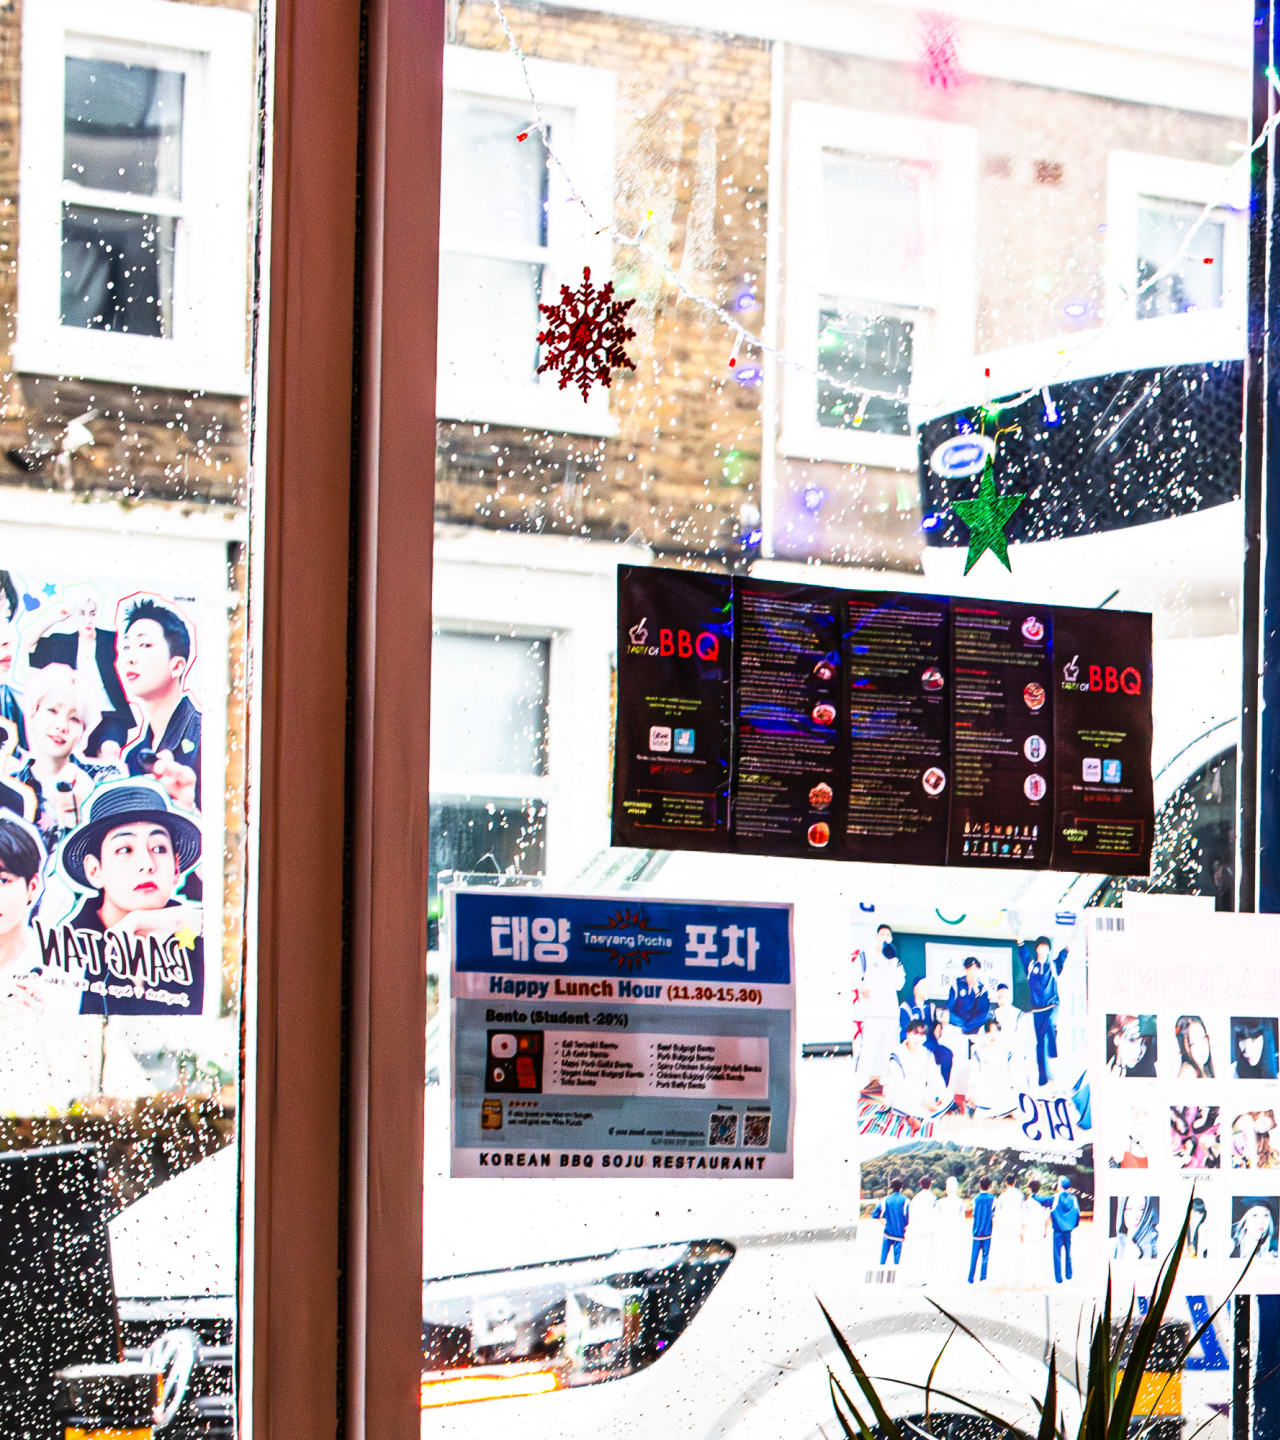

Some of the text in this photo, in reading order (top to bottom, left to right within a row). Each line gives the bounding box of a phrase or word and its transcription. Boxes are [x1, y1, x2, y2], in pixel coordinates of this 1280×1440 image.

[659, 628, 720, 662] BBQ
[1089, 664, 1141, 695] BBQ
[491, 914, 572, 964] 태양
[684, 924, 761, 972] 포차
[489, 975, 763, 1005] Happy Lunch Hour (11.30-15.30)
[485, 1009, 528, 1023] Bento
[530, 1010, 590, 1026] (Student
[479, 1152, 767, 1170] KOREAN BBQ SOJU RESTAURANT
